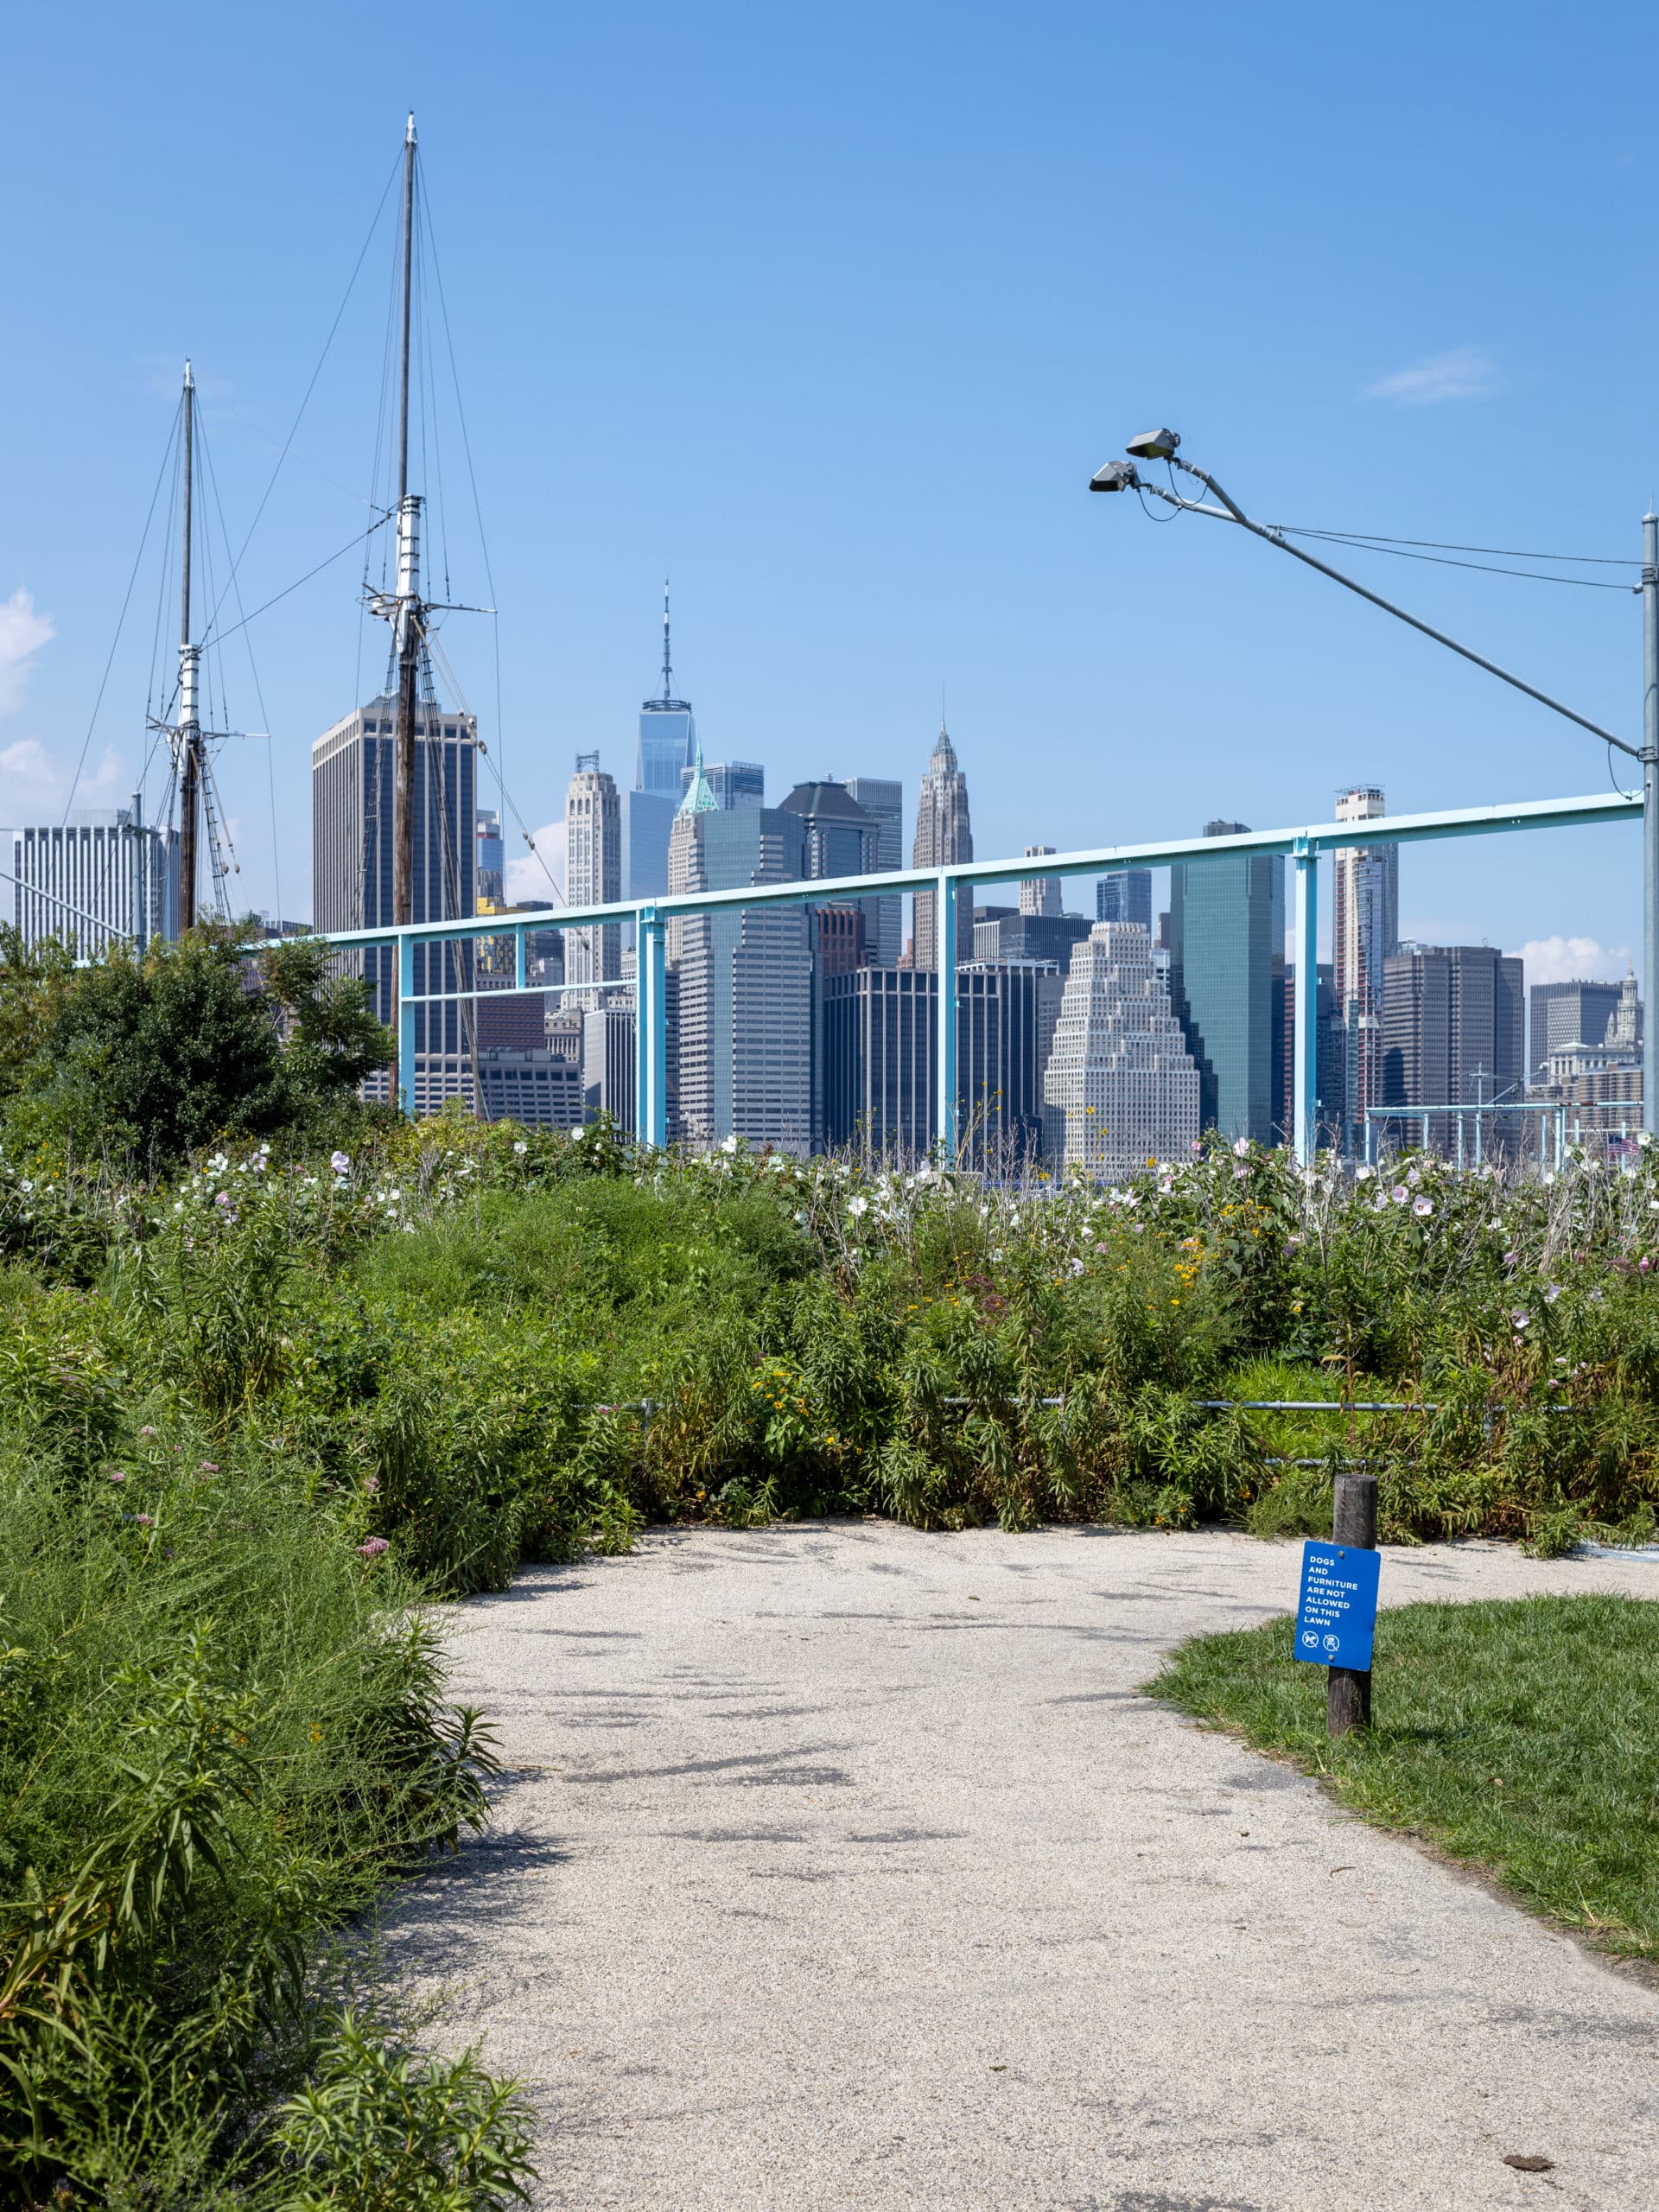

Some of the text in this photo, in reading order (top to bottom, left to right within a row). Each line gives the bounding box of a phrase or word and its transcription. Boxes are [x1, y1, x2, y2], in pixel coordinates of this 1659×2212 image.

[1310, 1556, 1335, 1566] DOGS
[1309, 1567, 1328, 1575] AND
[1307, 1576, 1357, 1590] FURNITURE
[1306, 1586, 1325, 1595] ARE
[1306, 1596, 1350, 1609] ALLOWED
[1320, 1608, 1340, 1618] THIS
[1304, 1616, 1331, 1626] LAWN
